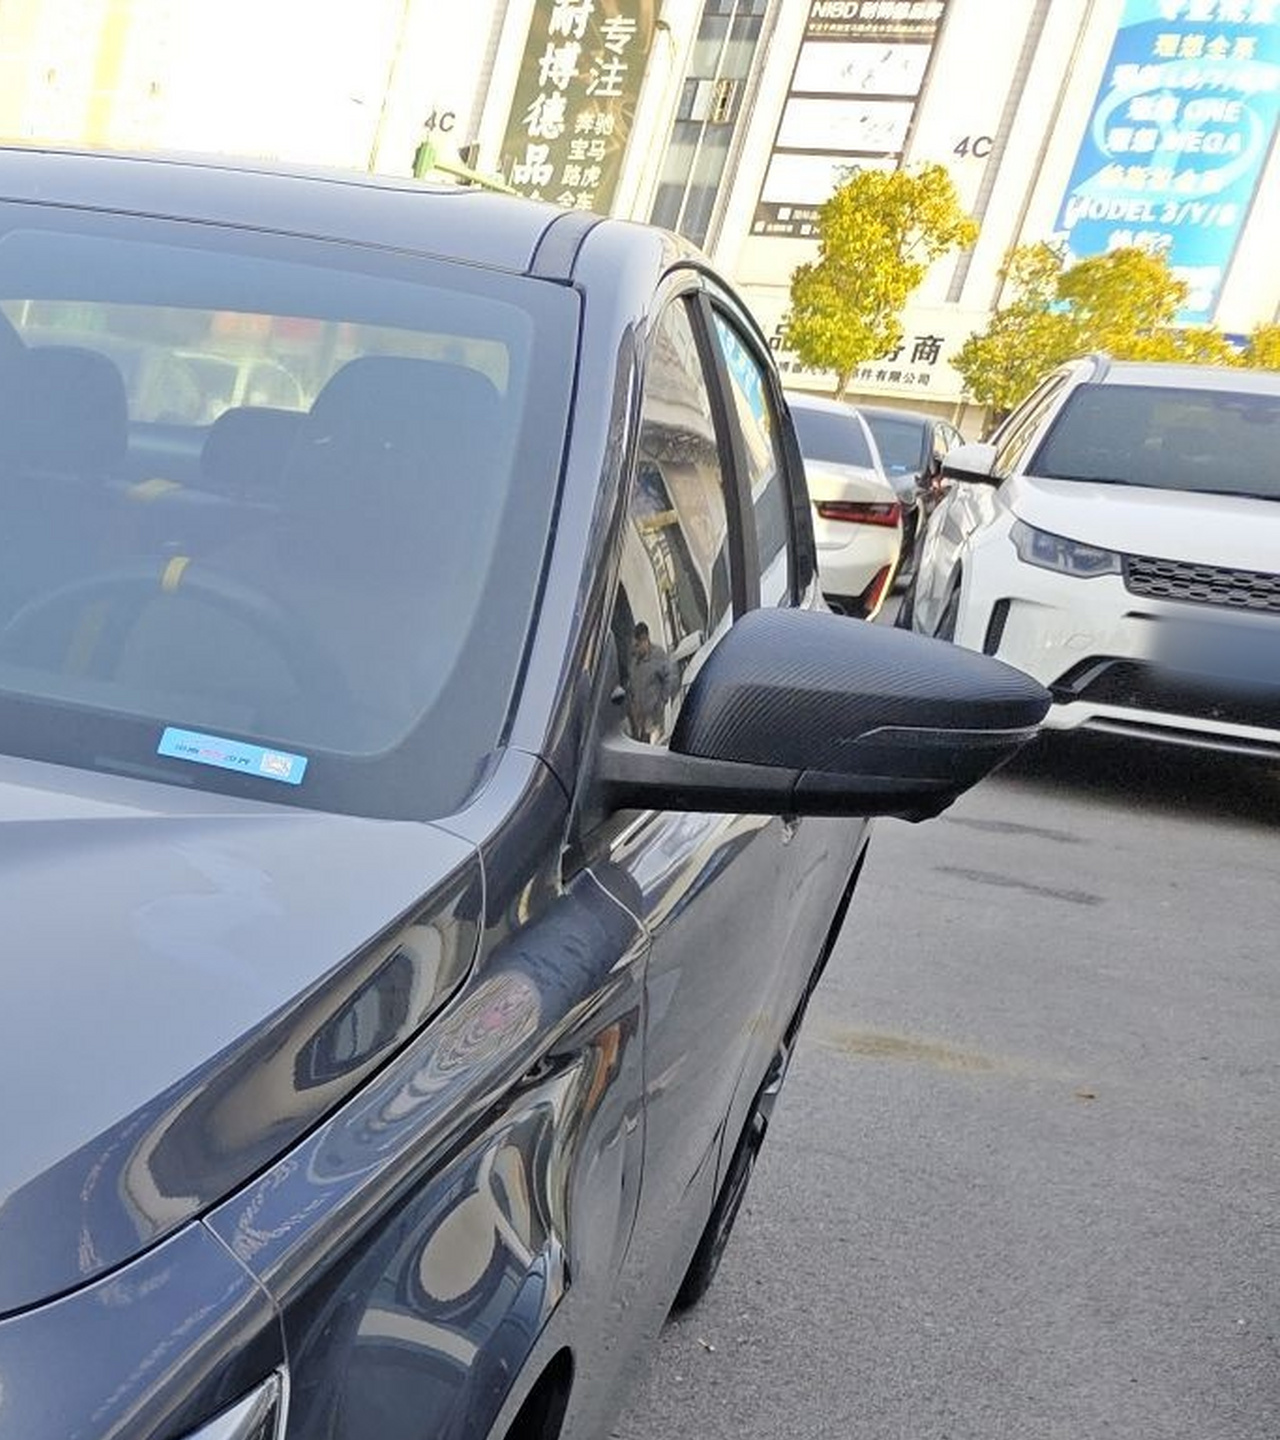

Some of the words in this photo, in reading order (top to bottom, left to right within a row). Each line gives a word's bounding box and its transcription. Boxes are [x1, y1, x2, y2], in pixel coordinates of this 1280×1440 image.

[586, 14, 637, 96] 专注
[424, 109, 456, 132] 4C
[574, 111, 615, 136] 奔驰
[567, 138, 607, 162] 宝马
[953, 136, 993, 158] 4C
[560, 164, 602, 187] 路虎
